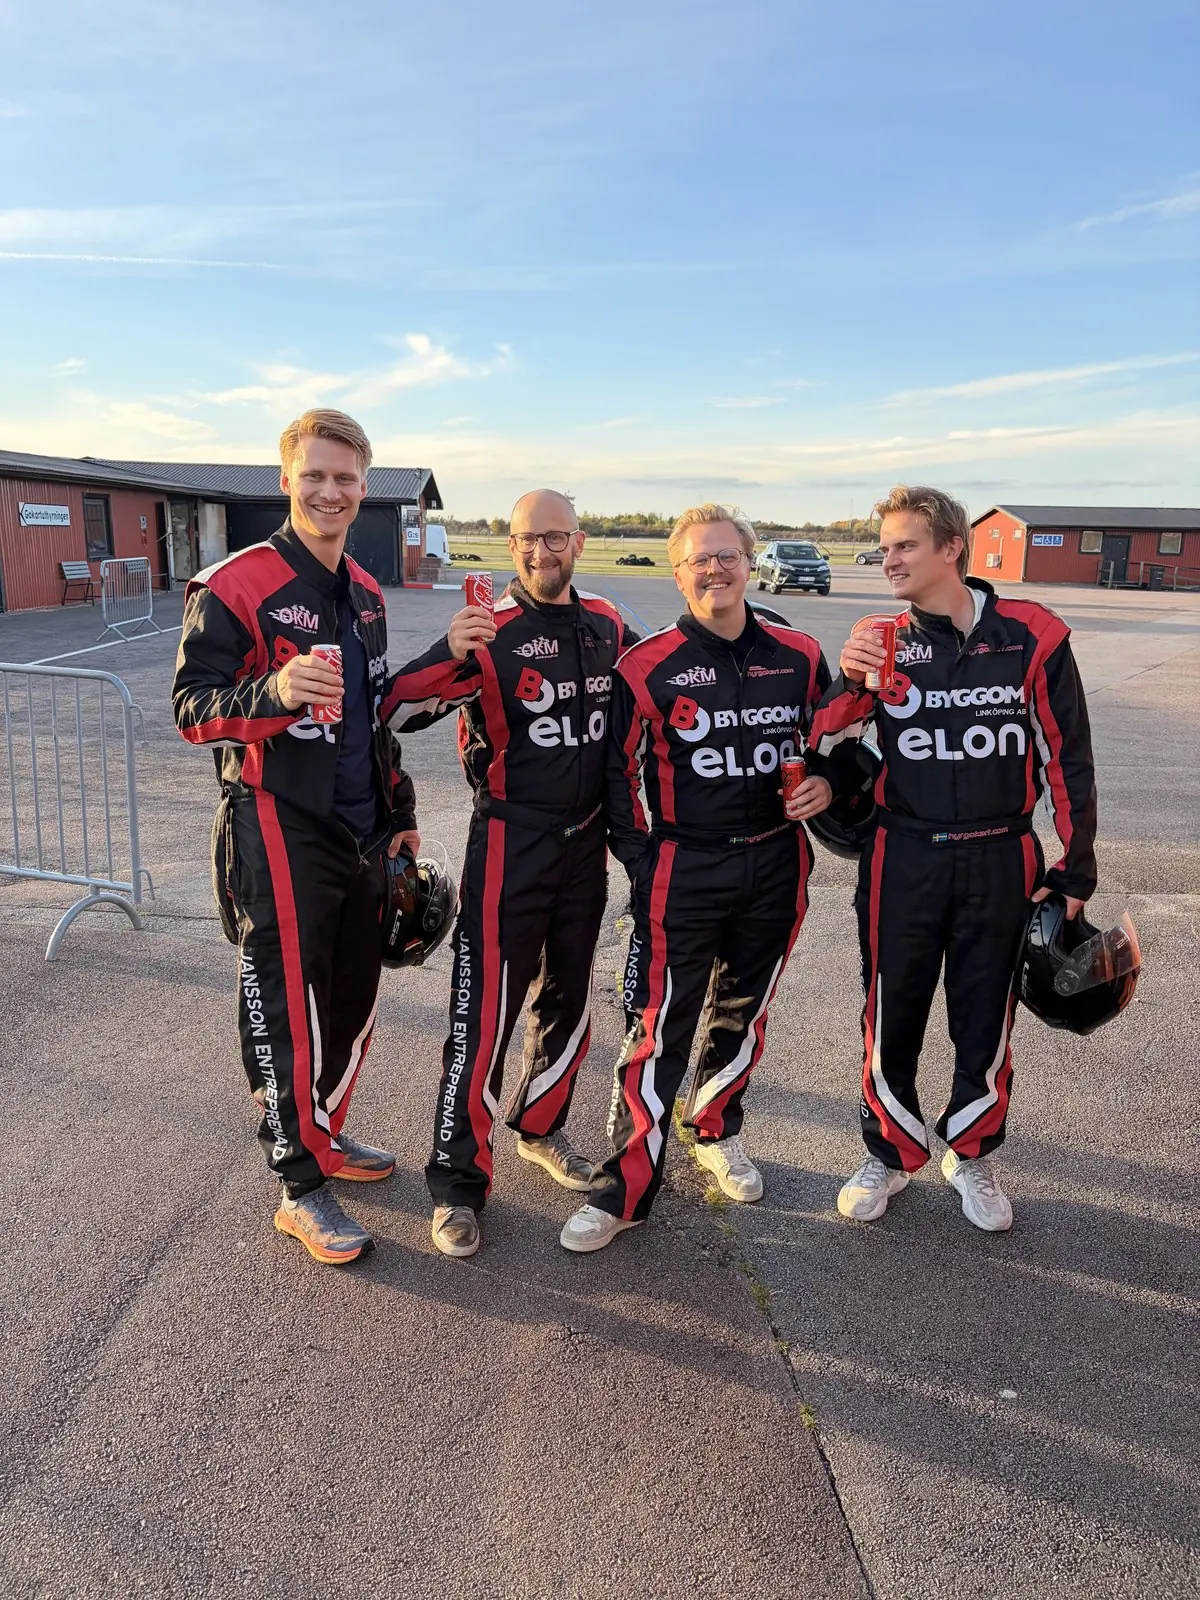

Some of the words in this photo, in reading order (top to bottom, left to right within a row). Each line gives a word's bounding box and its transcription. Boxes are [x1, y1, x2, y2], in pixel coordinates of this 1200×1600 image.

[278, 607, 319, 630] OKM
[521, 639, 559, 658] OKM
[557, 675, 613, 700] BYGGO
[675, 667, 717, 687] OKM
[925, 685, 1026, 709] BYGGOM
[713, 705, 800, 729] BYGGOM
[975, 707, 1015, 717] LINKÖPING
[1016, 708, 1027, 716] AB
[456, 931, 472, 1015] JANSSON
[623, 932, 643, 1013] JANSSON
[240, 946, 269, 1037] JANSSON
[440, 1022, 467, 1142] ENTREPRENAD
[254, 1043, 289, 1161] ENTREPRENAD
